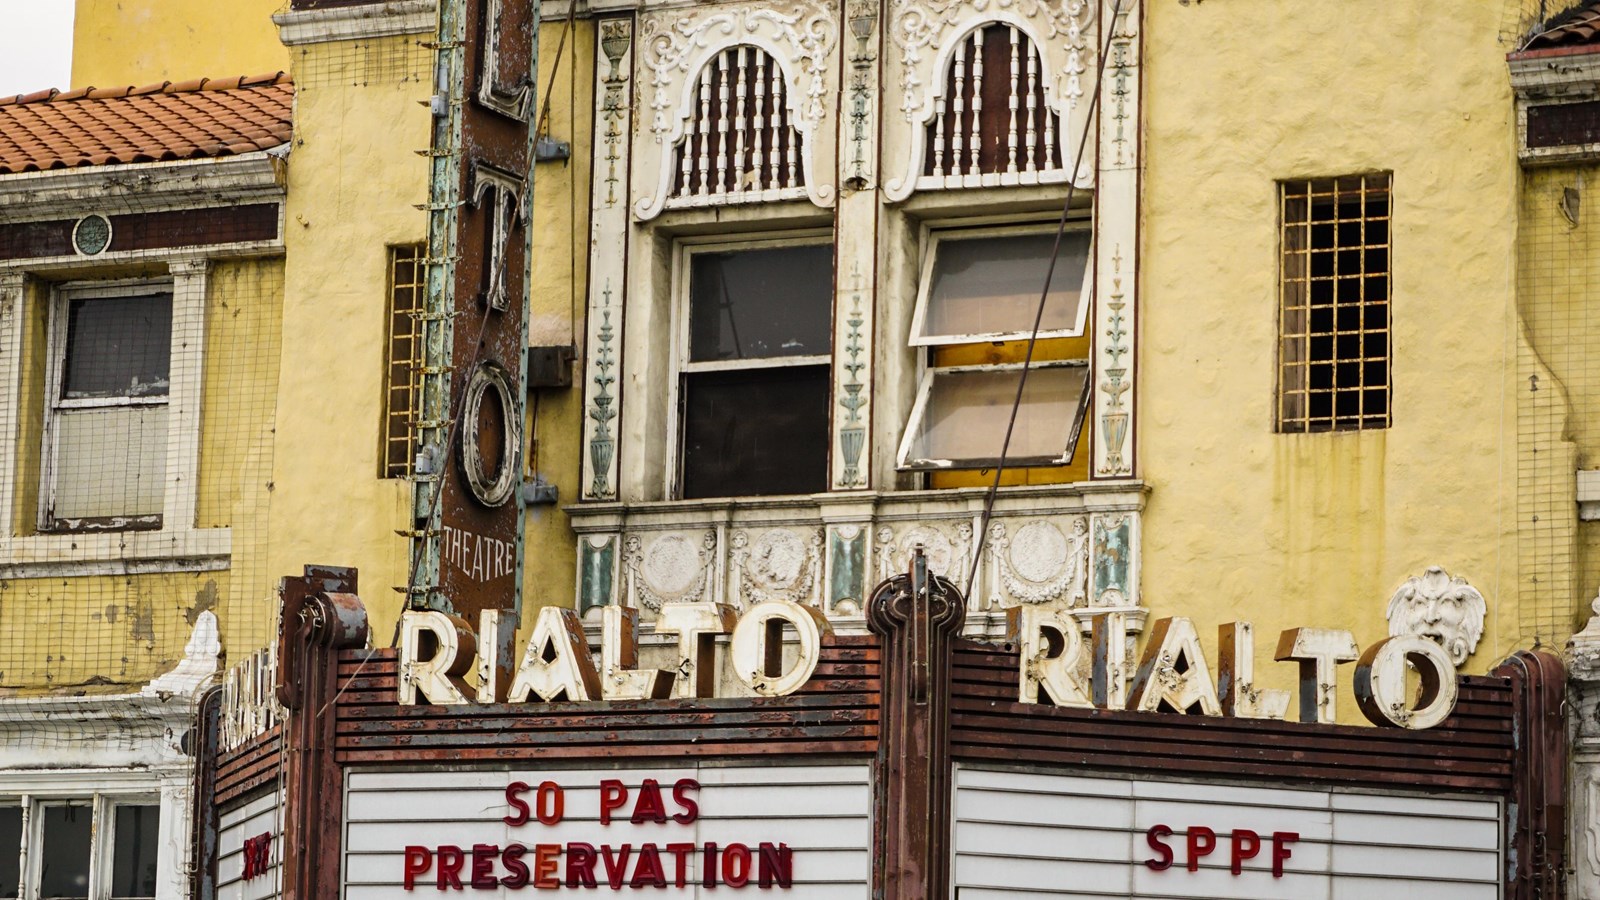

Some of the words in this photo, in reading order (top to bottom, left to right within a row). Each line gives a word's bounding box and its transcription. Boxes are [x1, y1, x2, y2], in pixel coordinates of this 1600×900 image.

[443, 525, 514, 583] THEATRE
[398, 601, 822, 706] RIALTO
[1010, 605, 1458, 730] RIALTO
[502, 780, 565, 827] SO
[600, 778, 700, 826] PAS
[403, 841, 793, 891] PRESERVATION
[1145, 824, 1300, 878] SPPF
